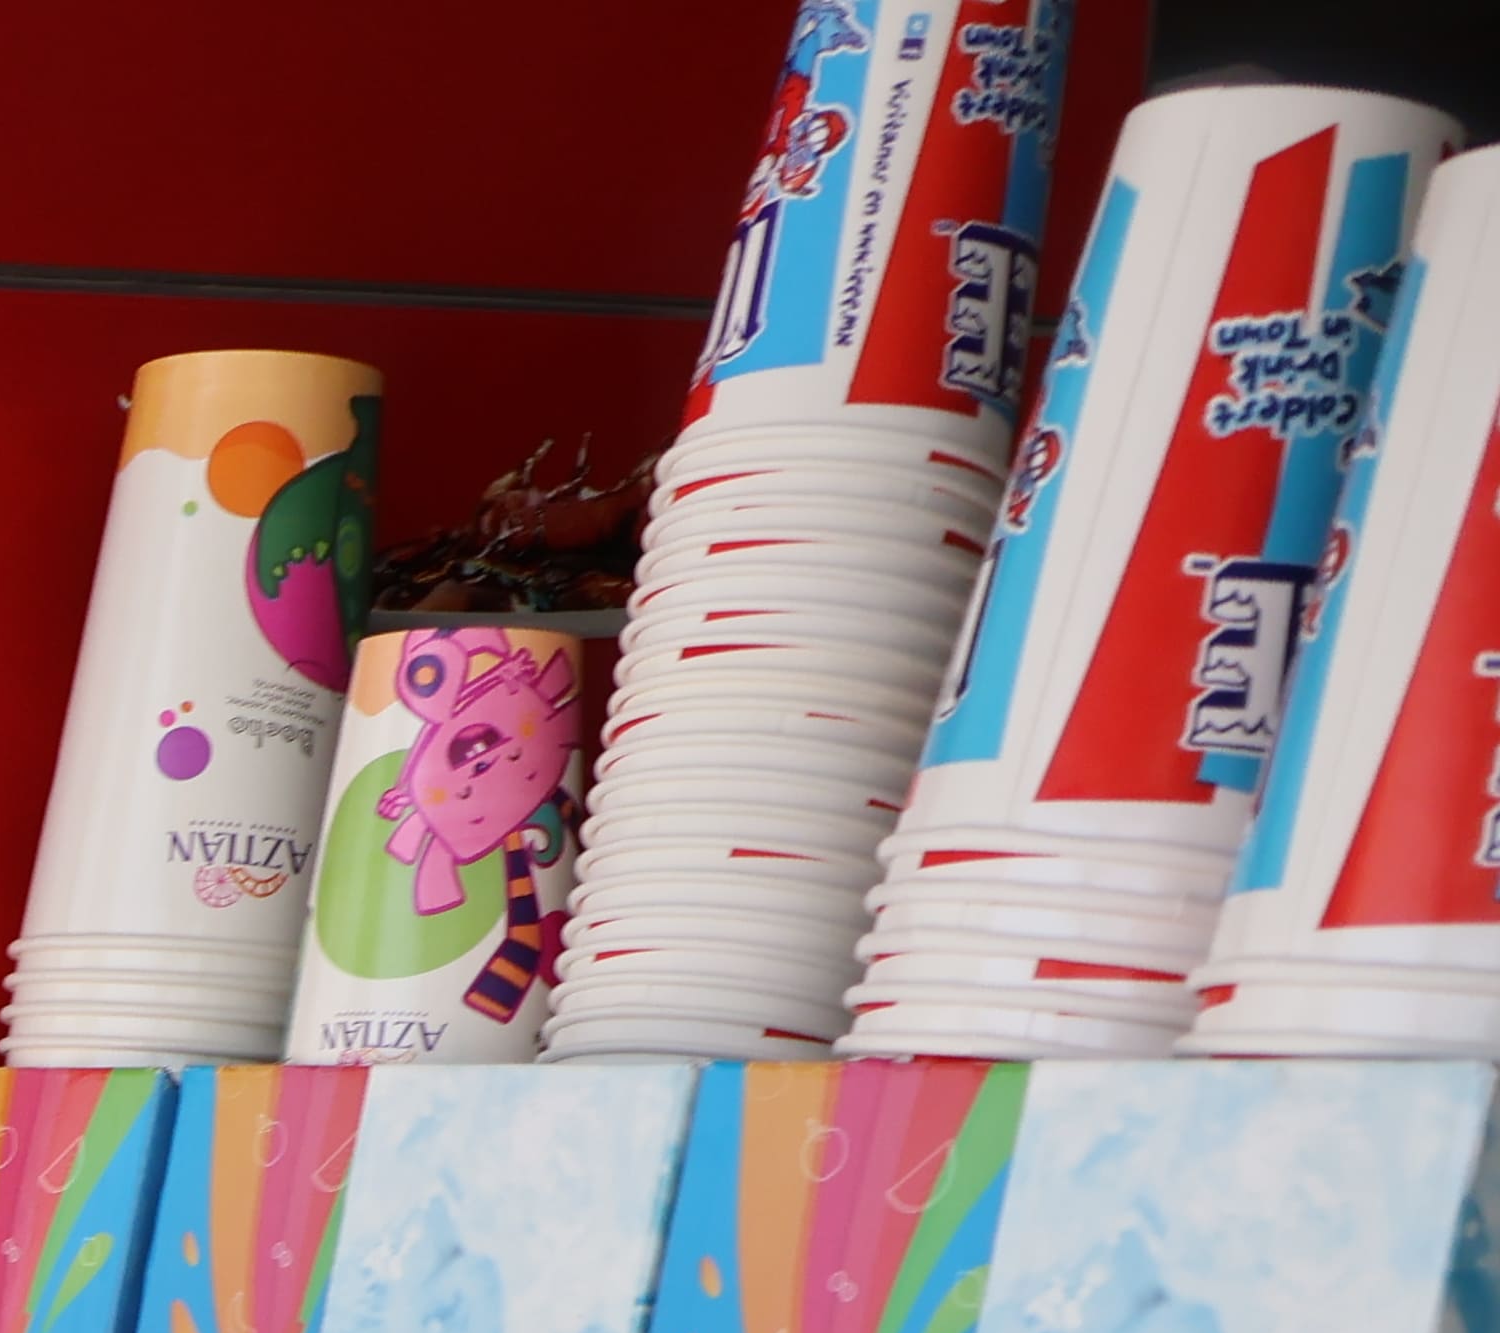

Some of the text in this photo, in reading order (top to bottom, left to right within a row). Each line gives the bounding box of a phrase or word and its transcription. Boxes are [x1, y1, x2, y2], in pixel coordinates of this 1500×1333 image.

[1216, 317, 1311, 352] Town
[1237, 351, 1340, 393] Drink
[1212, 394, 1360, 433] Coldest
